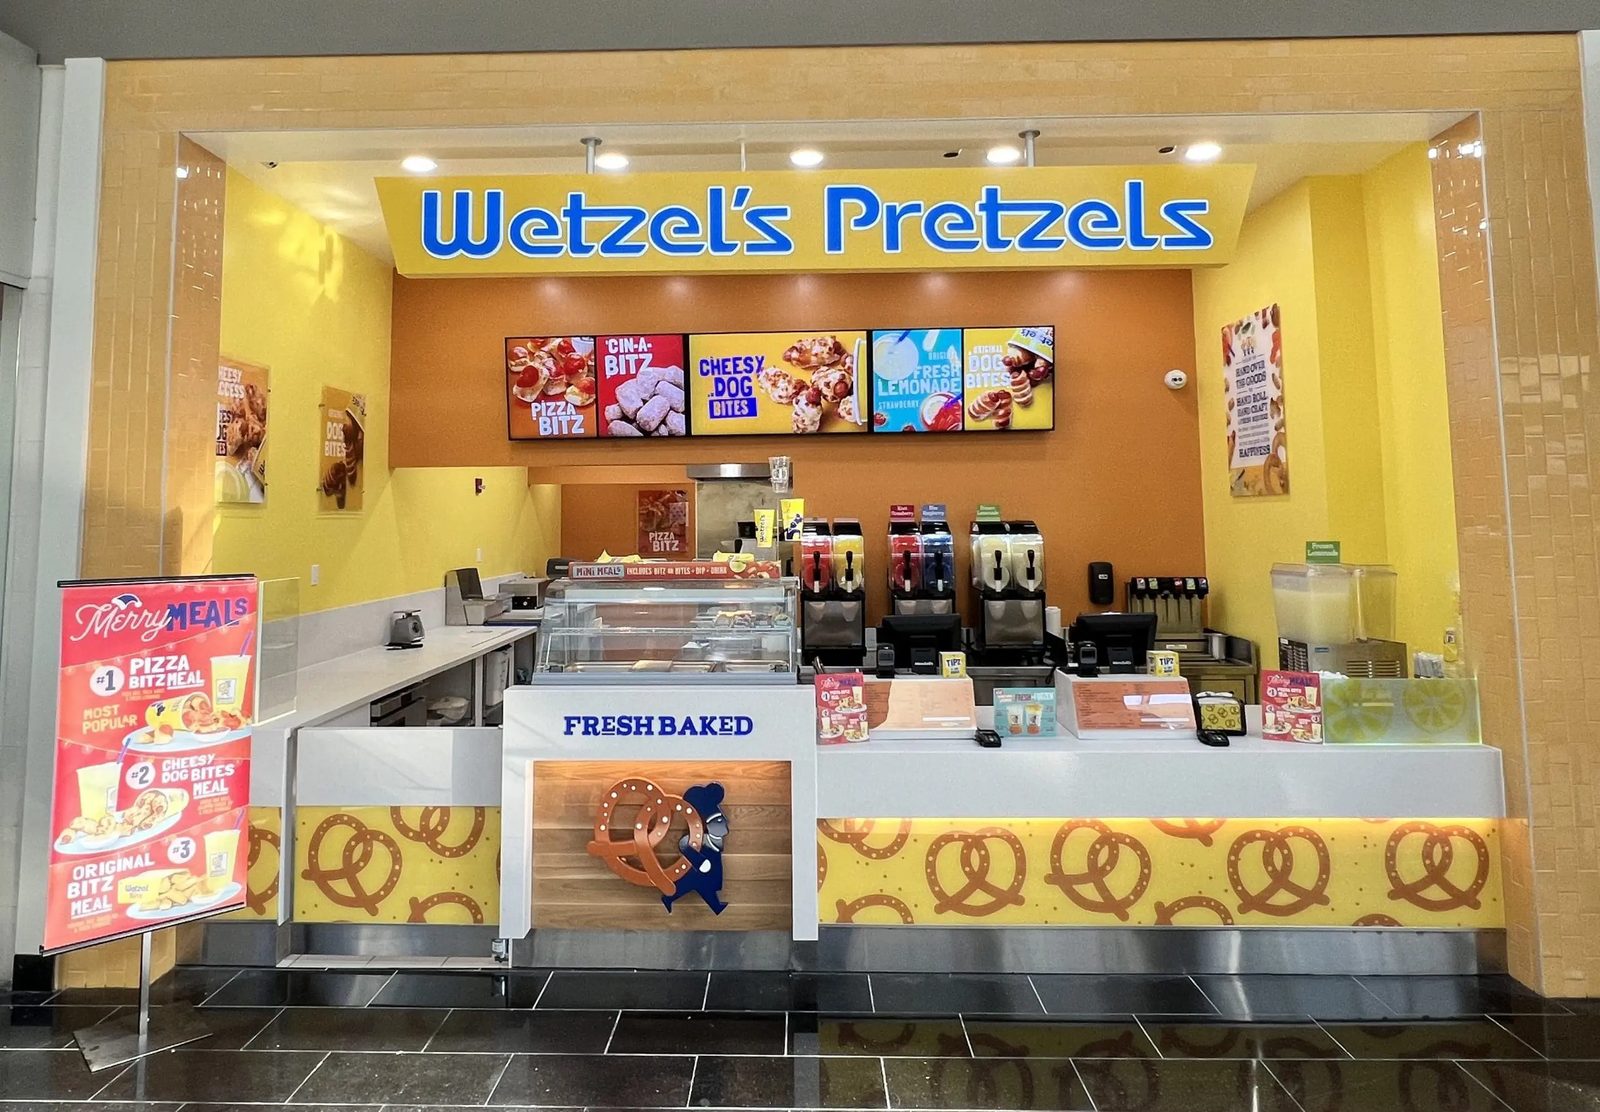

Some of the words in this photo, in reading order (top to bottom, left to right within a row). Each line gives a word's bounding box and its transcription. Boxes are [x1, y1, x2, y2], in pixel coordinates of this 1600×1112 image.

[420, 186, 794, 260] Wetzel's
[823, 181, 1212, 255] Pretzels
[604, 353, 653, 379] BITZ
[699, 355, 765, 377] CHEESY
[914, 365, 960, 380] FRESH
[969, 354, 1006, 373] DOG
[713, 376, 754, 399] DOG
[878, 378, 962, 396] LEMONADE
[966, 372, 1011, 388] BITES
[531, 400, 576, 422] PIZZA
[713, 399, 750, 417] BITES
[539, 415, 584, 437] BITZ
[649, 531, 675, 543] PIZZA
[653, 540, 680, 552] BITZ
[70, 603, 172, 642] Merry
[165, 598, 248, 632] MEALS
[129, 655, 190, 675] PIZZA
[96, 669, 116, 692] #1
[128, 672, 166, 689] BITZ
[166, 669, 205, 690] MEAL
[83, 703, 120, 720] MOST
[82, 713, 138, 734] POPULAR
[564, 715, 655, 736] FRESH
[658, 715, 754, 736] BAKED
[162, 753, 216, 772] CHEESY
[131, 765, 149, 785] #2
[161, 769, 190, 784] DOG
[191, 763, 235, 783] BITES
[192, 778, 229, 799] MEAL
[170, 839, 190, 860] #3
[73, 853, 156, 881] ORIGINAL
[67, 874, 114, 900] BITZ
[71, 895, 113, 919] MEAL
